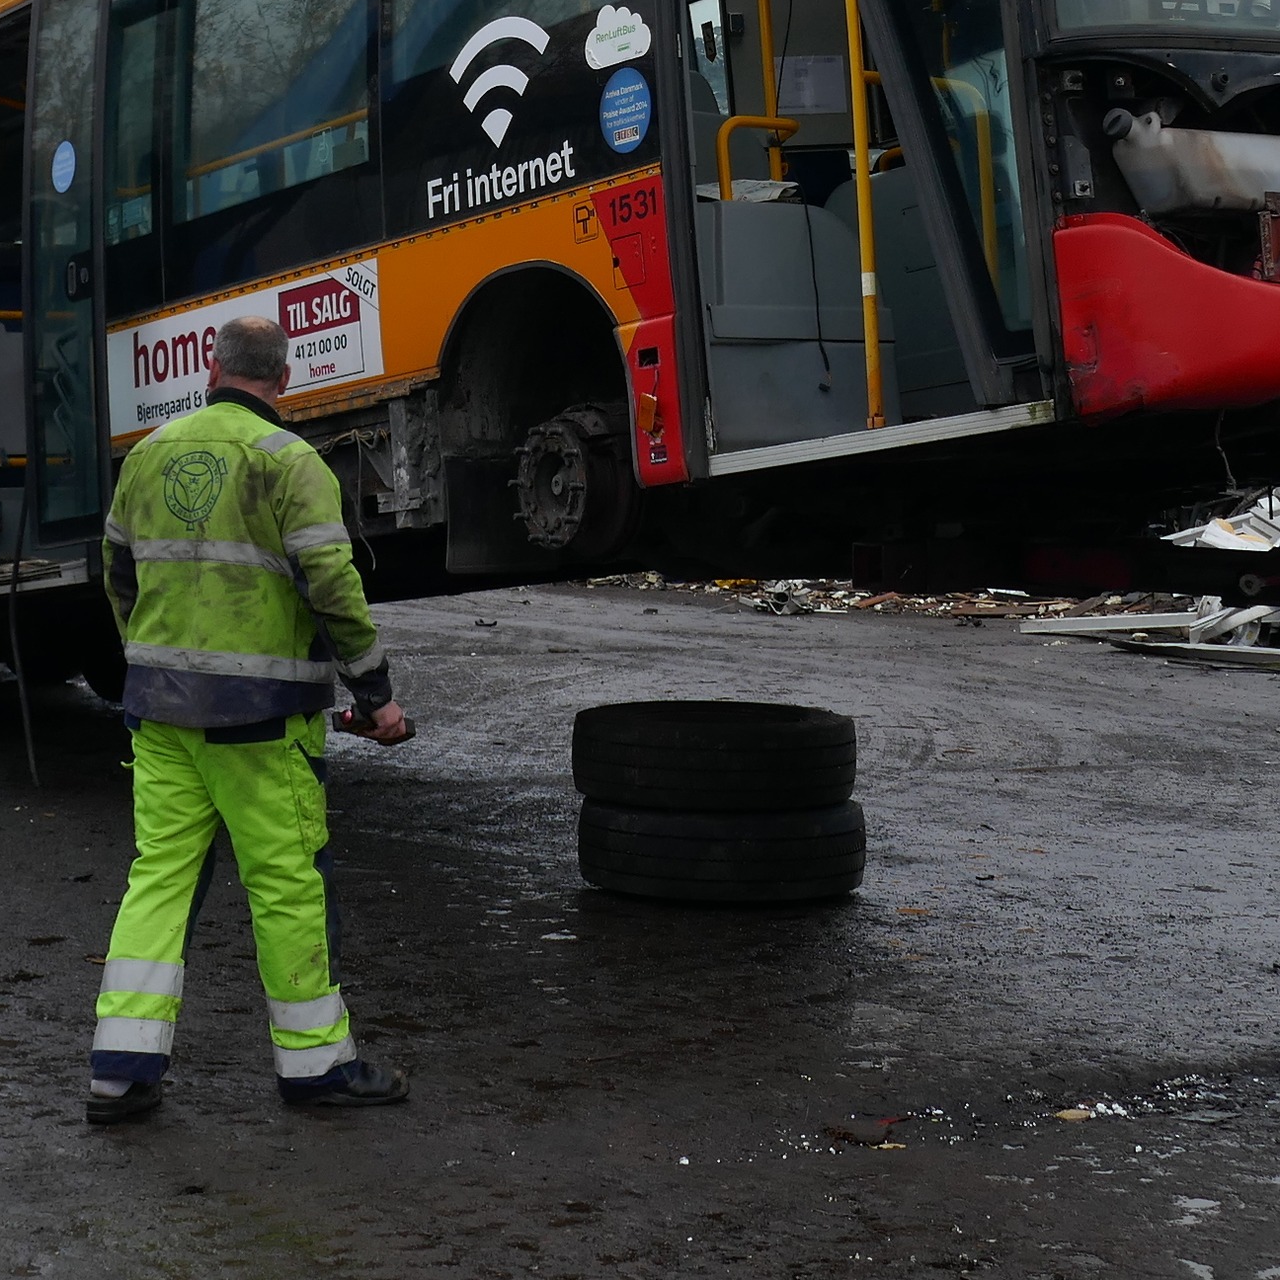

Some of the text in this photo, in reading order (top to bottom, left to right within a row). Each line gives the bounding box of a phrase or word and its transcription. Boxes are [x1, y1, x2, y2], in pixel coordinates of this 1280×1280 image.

[595, 24, 636, 44] RenLuftBus
[621, 82, 643, 95] Danmark
[629, 95, 634, 103] af
[603, 101, 648, 120] Praise Award 2014
[427, 139, 575, 219] Fri internet
[609, 186, 657, 226] 1531
[345, 267, 377, 299] SOLGT
[286, 289, 351, 332] TIL SALG
[133, 325, 217, 388] home
[295, 334, 347, 360] 41 21 00 00
[309, 362, 336, 378] home
[136, 391, 192, 423] Bjerregaard
[194, 390, 202, 408] &
